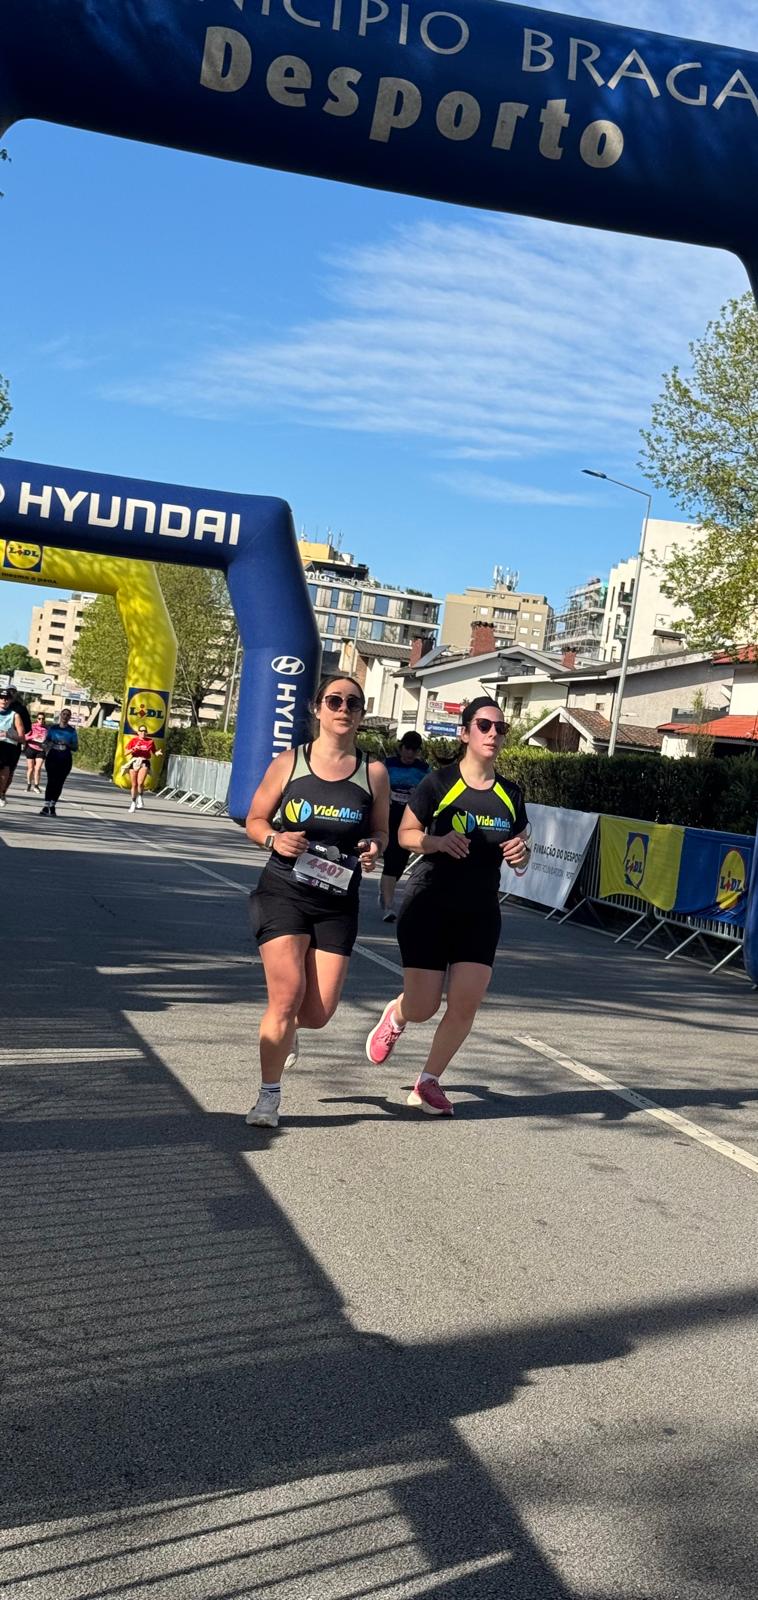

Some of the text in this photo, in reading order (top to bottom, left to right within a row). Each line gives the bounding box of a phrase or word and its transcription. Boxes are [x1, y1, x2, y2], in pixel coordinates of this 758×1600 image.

[198, 0, 758, 117] CIPIO BRAGA
[200, 26, 625, 168] Desporto
[18, 481, 241, 545] HYUNDAI
[313, 804, 362, 820] VidaMais
[475, 815, 511, 829] VidaMais
[307, 858, 344, 878] 4407
